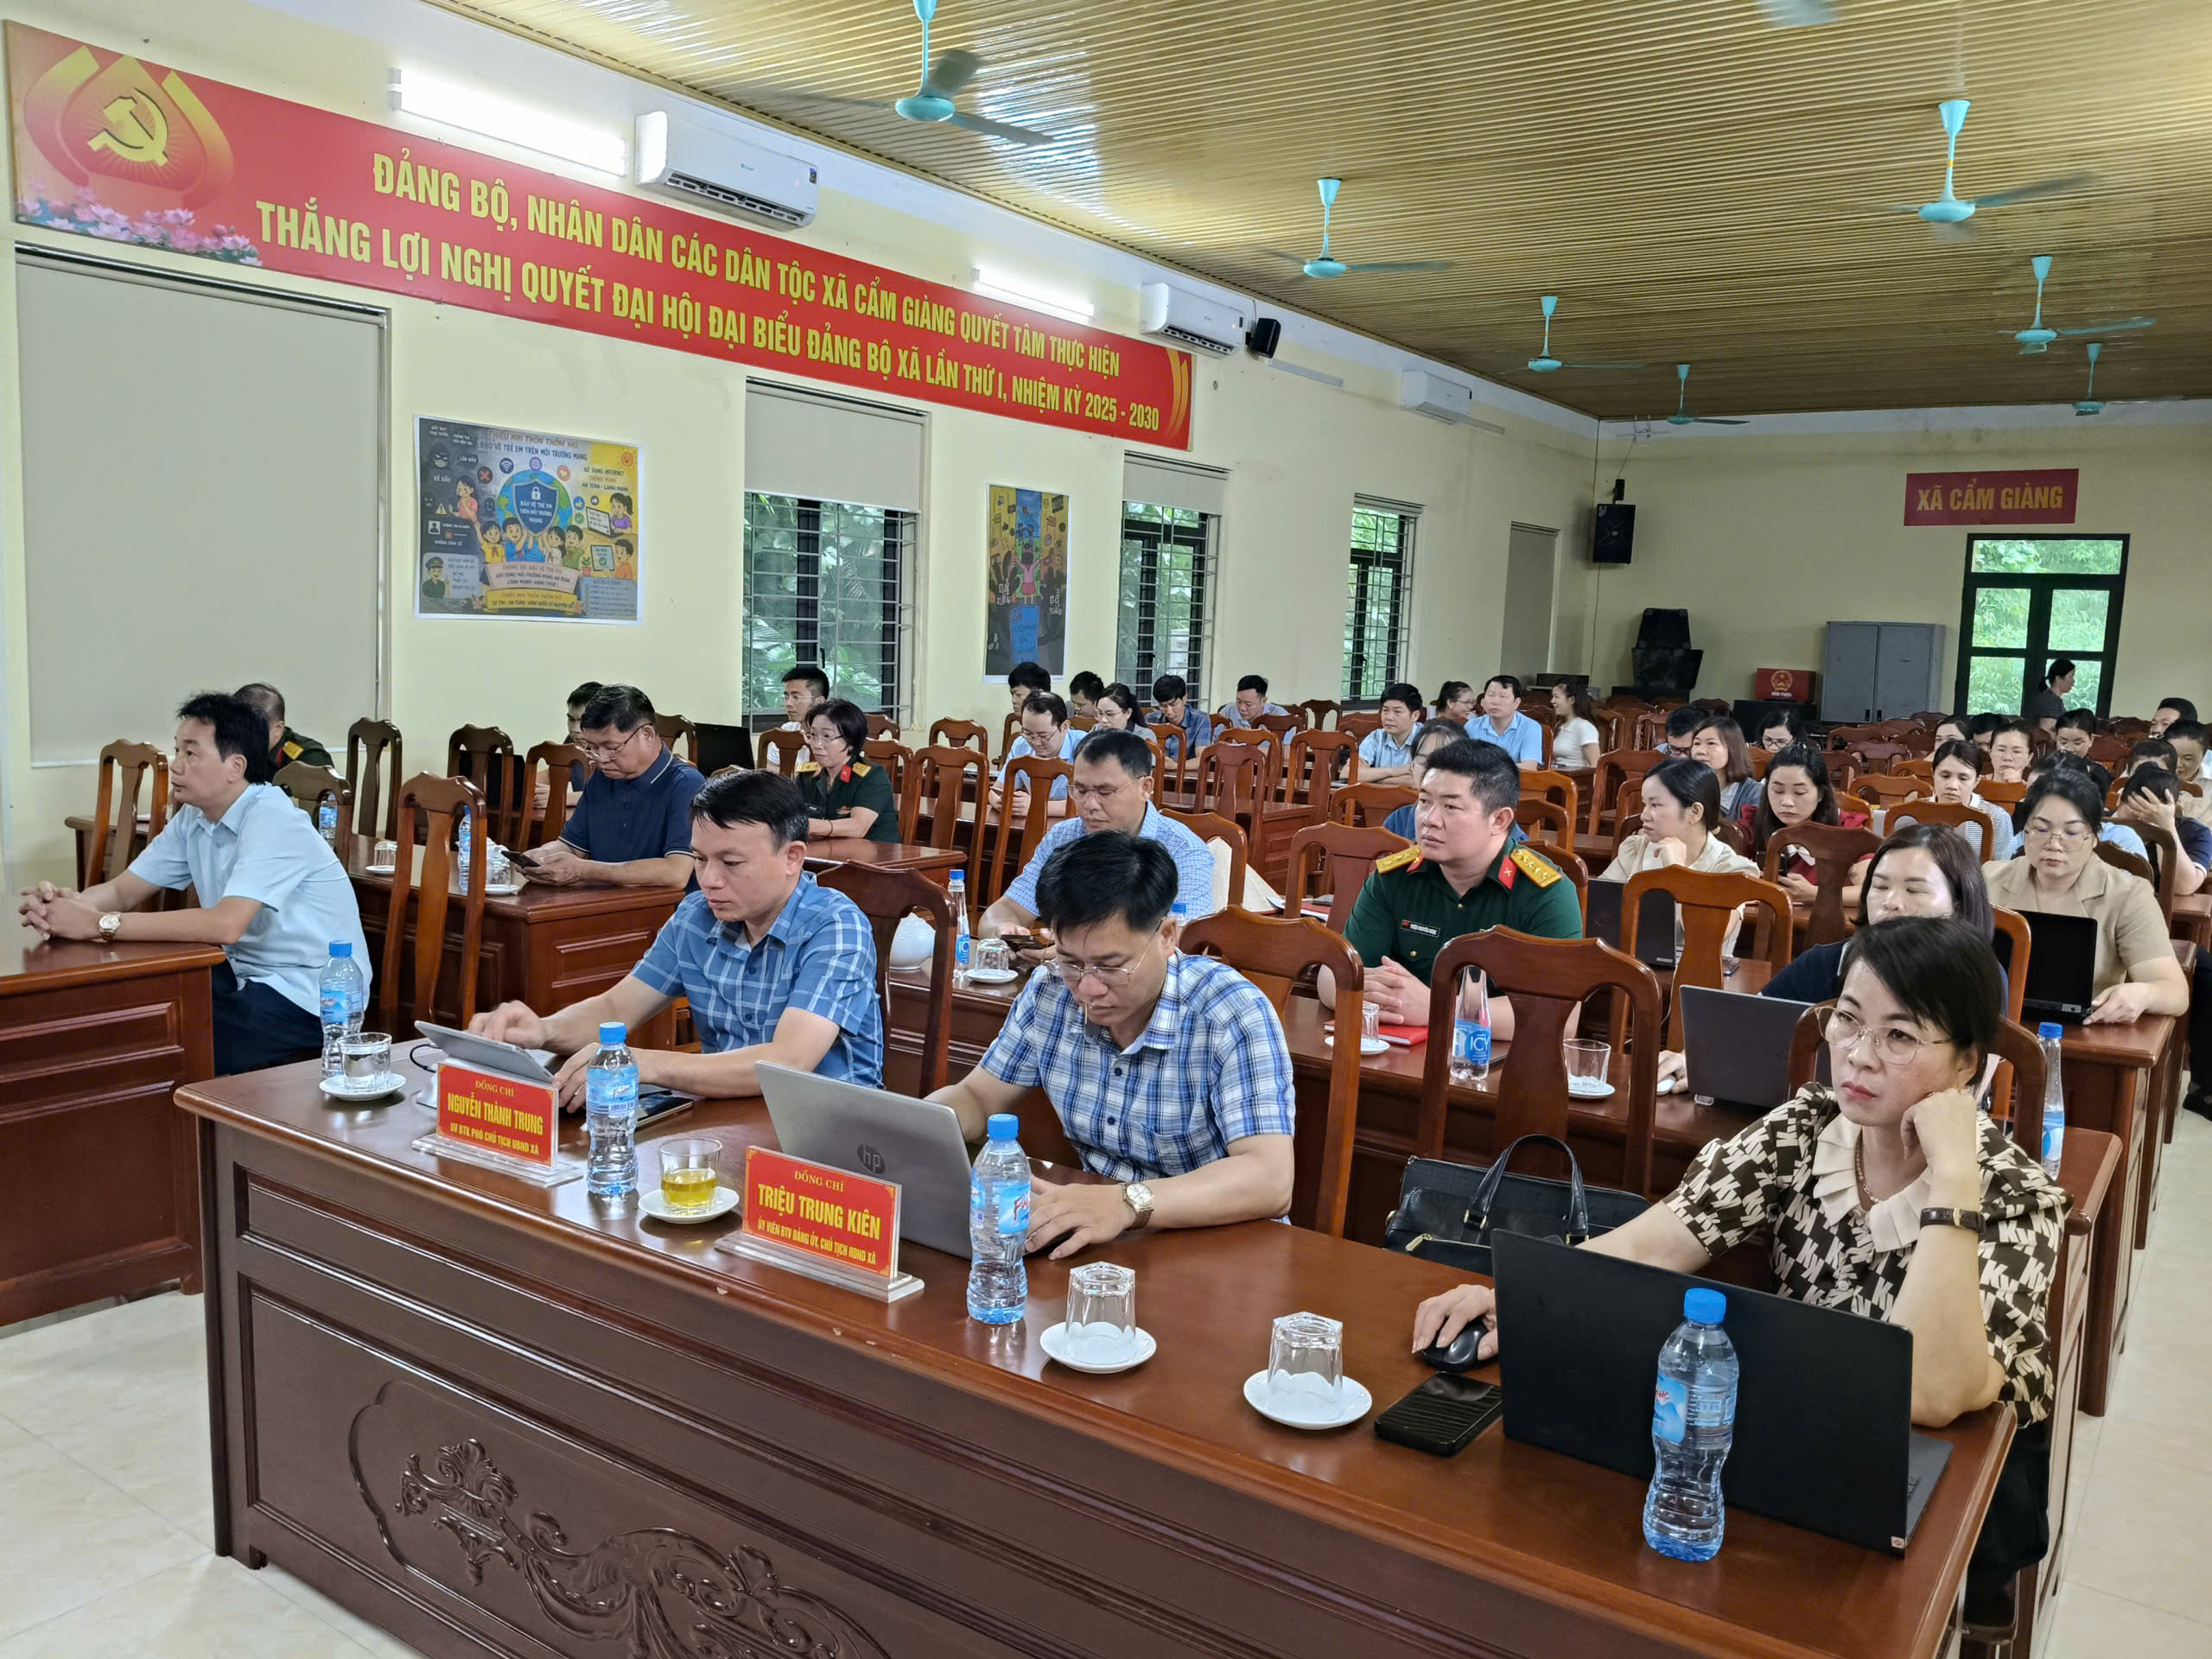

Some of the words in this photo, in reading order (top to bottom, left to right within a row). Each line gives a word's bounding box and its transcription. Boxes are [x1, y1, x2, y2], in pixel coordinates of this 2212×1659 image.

[373, 148, 461, 212] ĐẢNG
[471, 179, 518, 232] BỘ,
[527, 194, 603, 248] NHÂN
[612, 216, 664, 264] DÂN
[671, 232, 718, 277] CÁC
[725, 246, 771, 291] DÂN
[777, 261, 815, 306] TỘC
[822, 273, 848, 311] XÃ
[855, 276, 896, 322] CẨM
[903, 295, 955, 336] GIÀNG
[960, 311, 1009, 349] QUYẾT
[1014, 321, 1046, 359] TÂM
[1049, 334, 1085, 372] THỰC
[1089, 344, 1120, 379] HIỆN
[256, 197, 372, 263] THẮNG
[382, 228, 430, 281] LỢI
[442, 242, 512, 302] NGHỊ
[522, 262, 605, 313] QUYẾT
[613, 283, 653, 328] ĐẠI
[663, 292, 701, 339] HỘI
[709, 306, 747, 349] ĐẠI
[753, 310, 801, 356] BIỂU
[807, 322, 861, 369] ĐẢNG
[867, 339, 892, 380] BỘ
[898, 346, 921, 381] XÃ
[926, 346, 958, 388] LẦN
[963, 363, 996, 397] THỨ
[1013, 376, 1059, 413] NHIỆM
[1064, 384, 1081, 415] KỲ
[1085, 393, 1117, 422] 2025
[1129, 403, 1159, 431] 2030
[1916, 485, 1942, 511] XÃ
[1949, 478, 1995, 511] CẨM
[2000, 482, 2063, 509] GIÀNG
[1470, 1036, 1490, 1052] ICY
[475, 1079, 498, 1092] ĐỒNG
[499, 1085, 514, 1097] CHÍ
[448, 1091, 481, 1119] NGUYỄN
[484, 1100, 512, 1127] THÀNH
[514, 1109, 543, 1135] TRUNG
[863, 1147, 882, 1175] hp
[794, 1168, 823, 1186] ĐỒNG
[826, 1179, 844, 1192] CHÍ
[758, 1183, 795, 1217] TRIỆU
[798, 1195, 844, 1229] TRUNG
[847, 1209, 881, 1240] KIÊN
